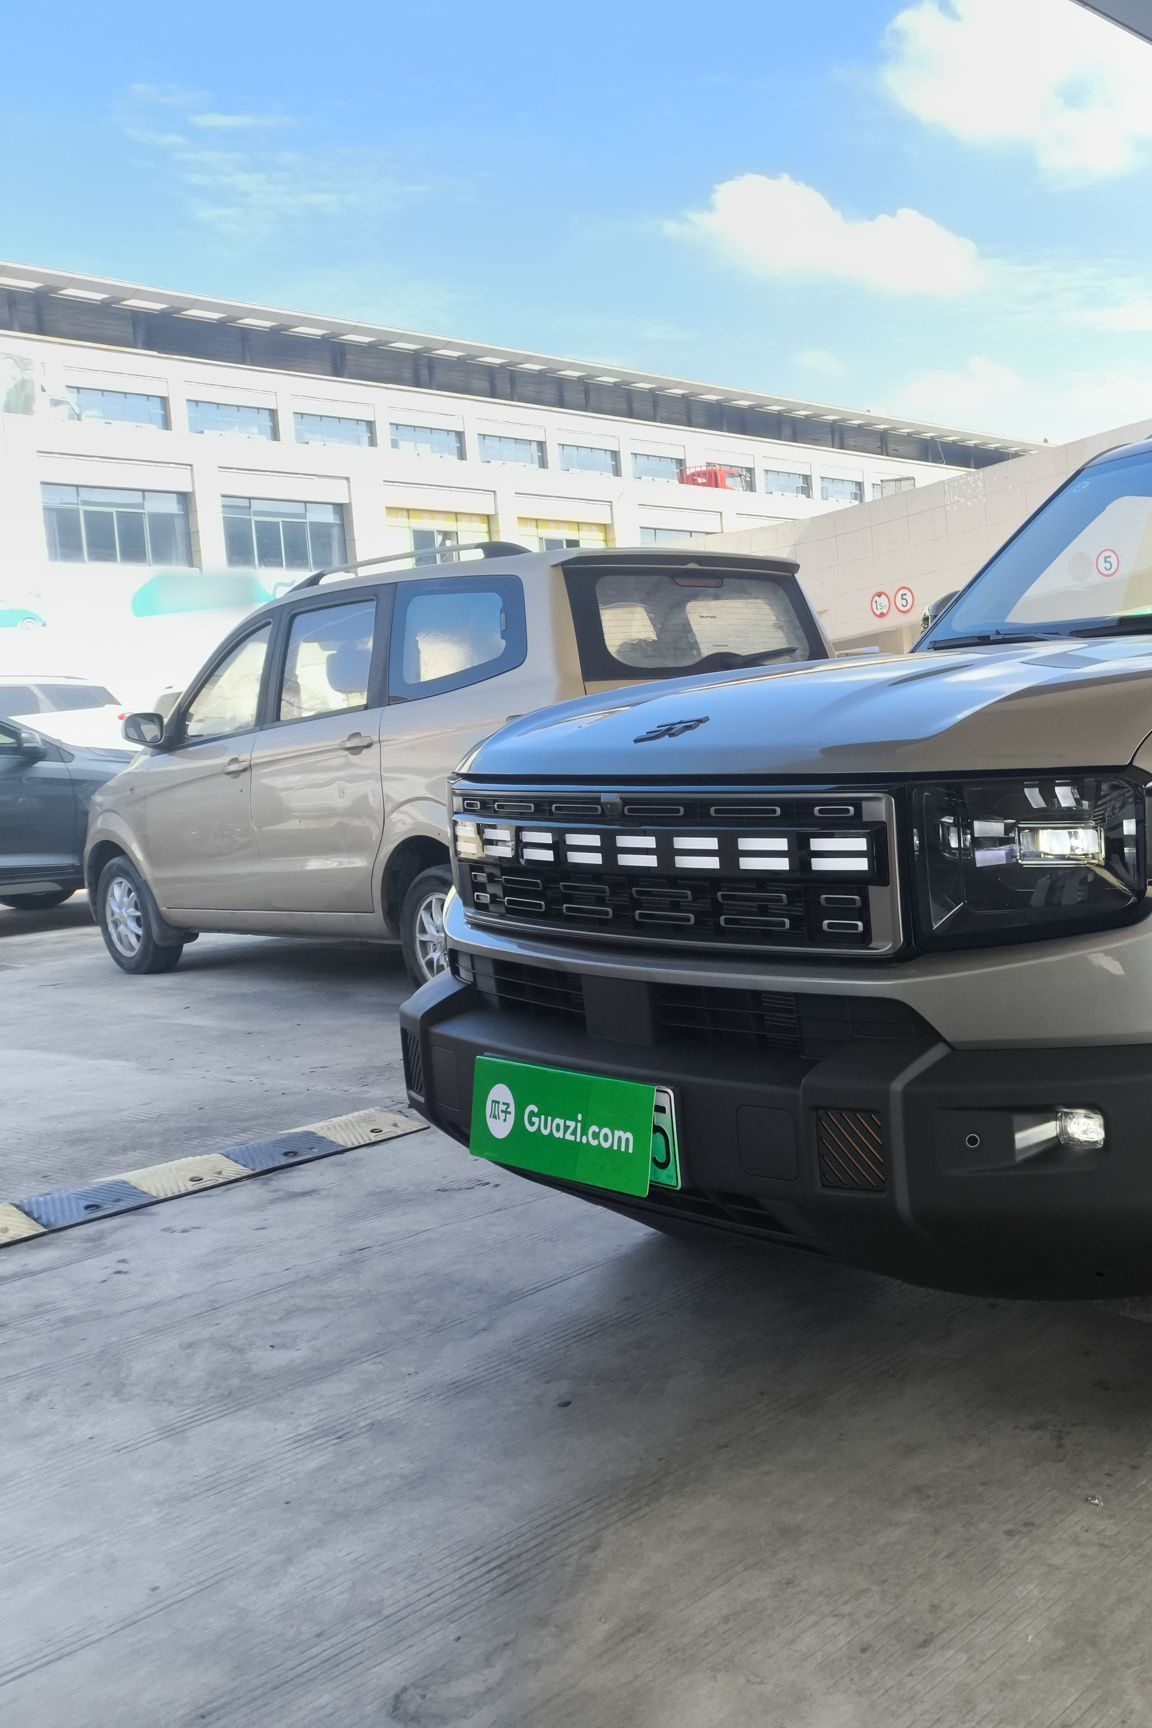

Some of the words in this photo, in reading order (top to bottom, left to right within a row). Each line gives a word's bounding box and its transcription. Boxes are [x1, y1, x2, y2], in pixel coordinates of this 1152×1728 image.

[1103, 555, 1113, 571] 5
[900, 592, 909, 608] 5
[489, 1099, 512, 1123] 瓜子
[524, 1104, 634, 1154] Guazi.com
